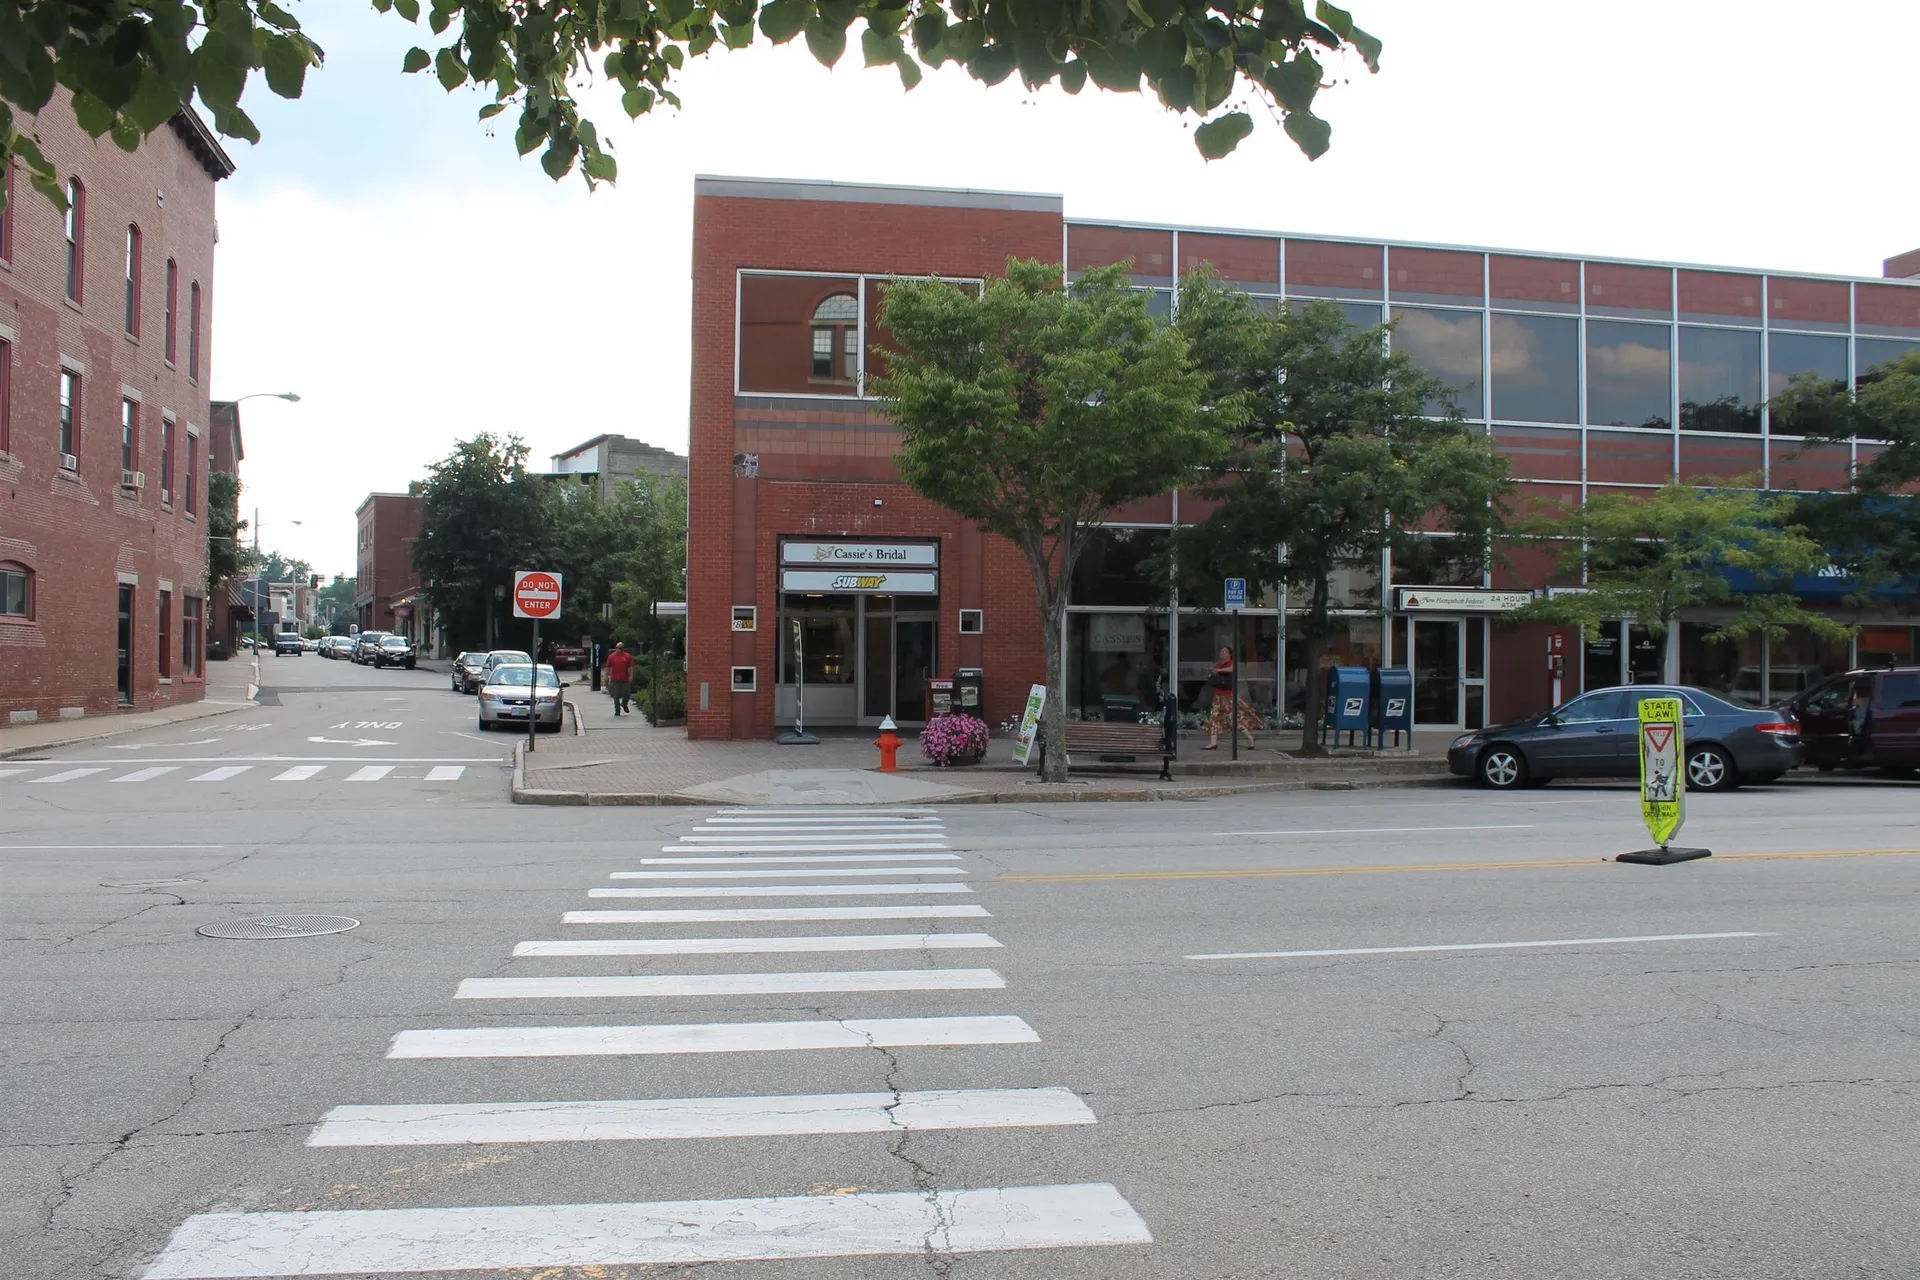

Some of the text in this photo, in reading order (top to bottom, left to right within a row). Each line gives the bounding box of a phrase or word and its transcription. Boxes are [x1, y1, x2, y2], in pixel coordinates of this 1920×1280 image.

[834, 549, 907, 560] Cassie's Bridal
[832, 575, 887, 589] SUBWAY
[1420, 596, 1435, 604] New
[524, 601, 551, 609] ENTER
[1643, 702, 1674, 710] STATE
[1647, 711, 1670, 719] LAW
[329, 721, 403, 729] ONLY
